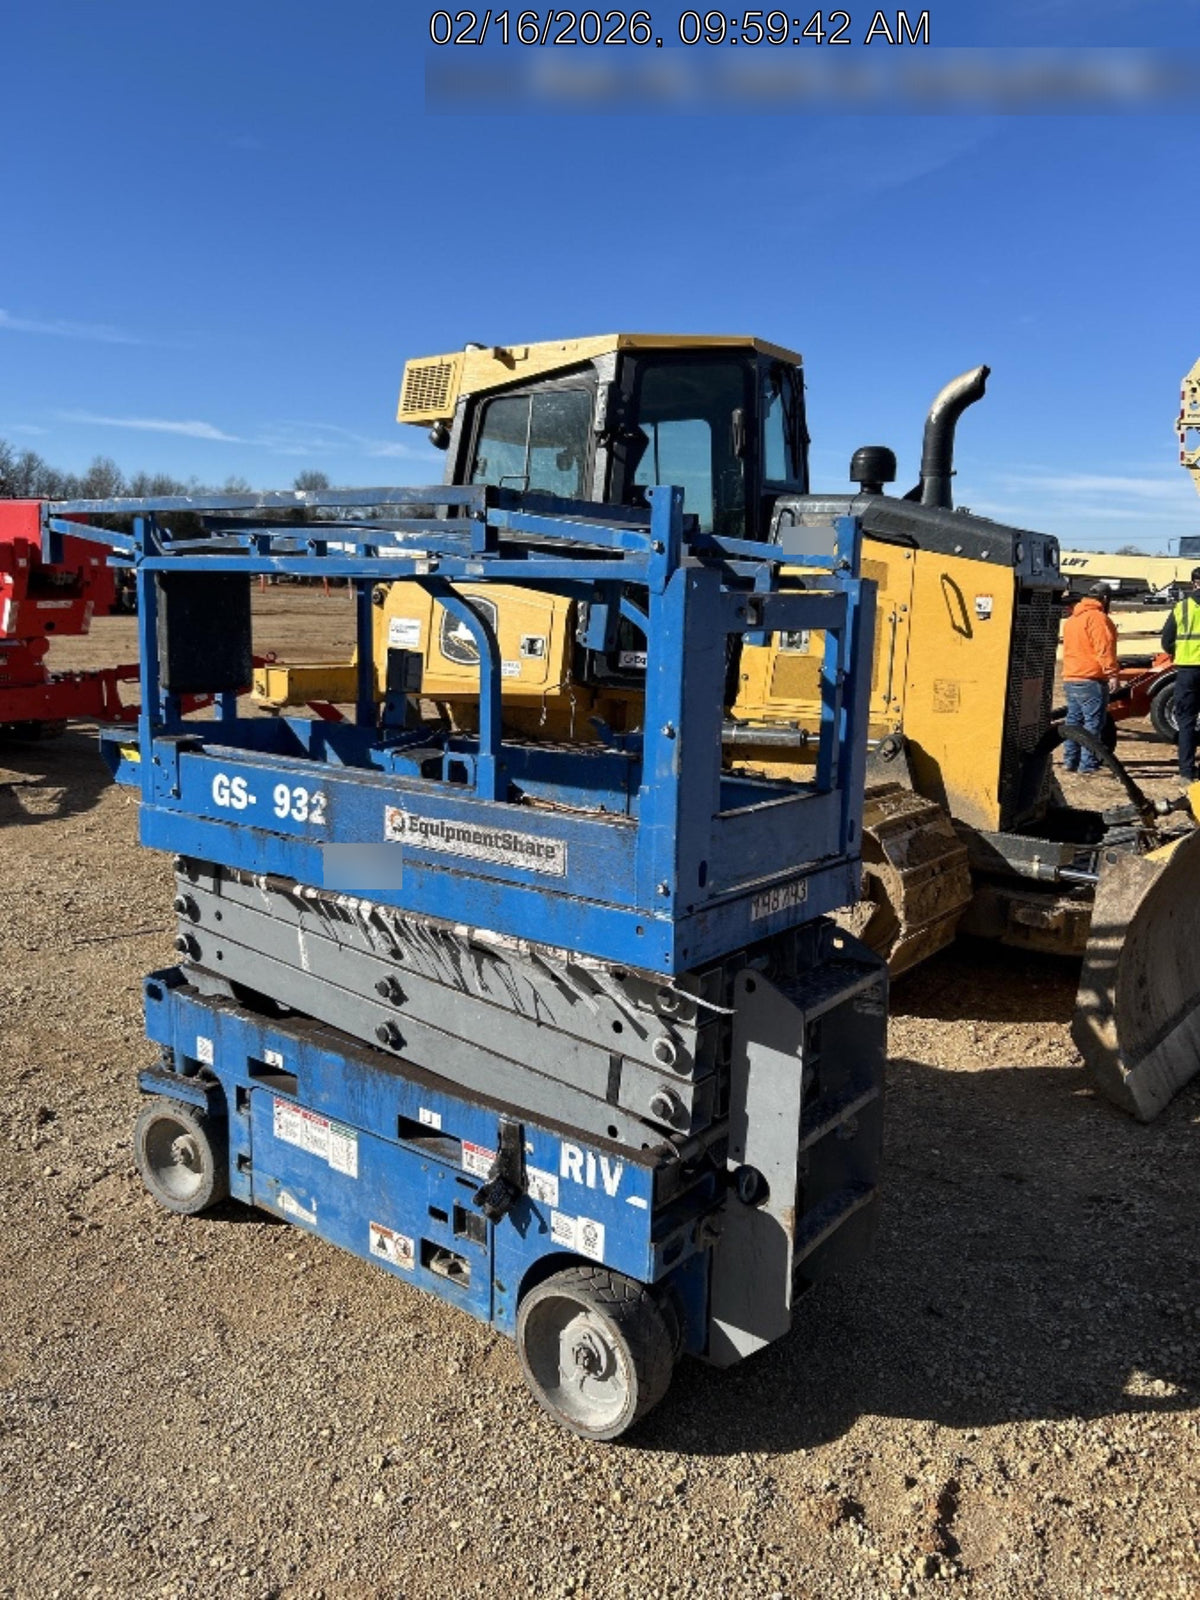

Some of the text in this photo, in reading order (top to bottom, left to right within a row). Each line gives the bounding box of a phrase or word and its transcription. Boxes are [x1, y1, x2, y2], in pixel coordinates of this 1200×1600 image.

[1061, 557, 1089, 568] LIFT
[212, 773, 257, 810] GS-
[408, 815, 556, 859] EquipmentShare
